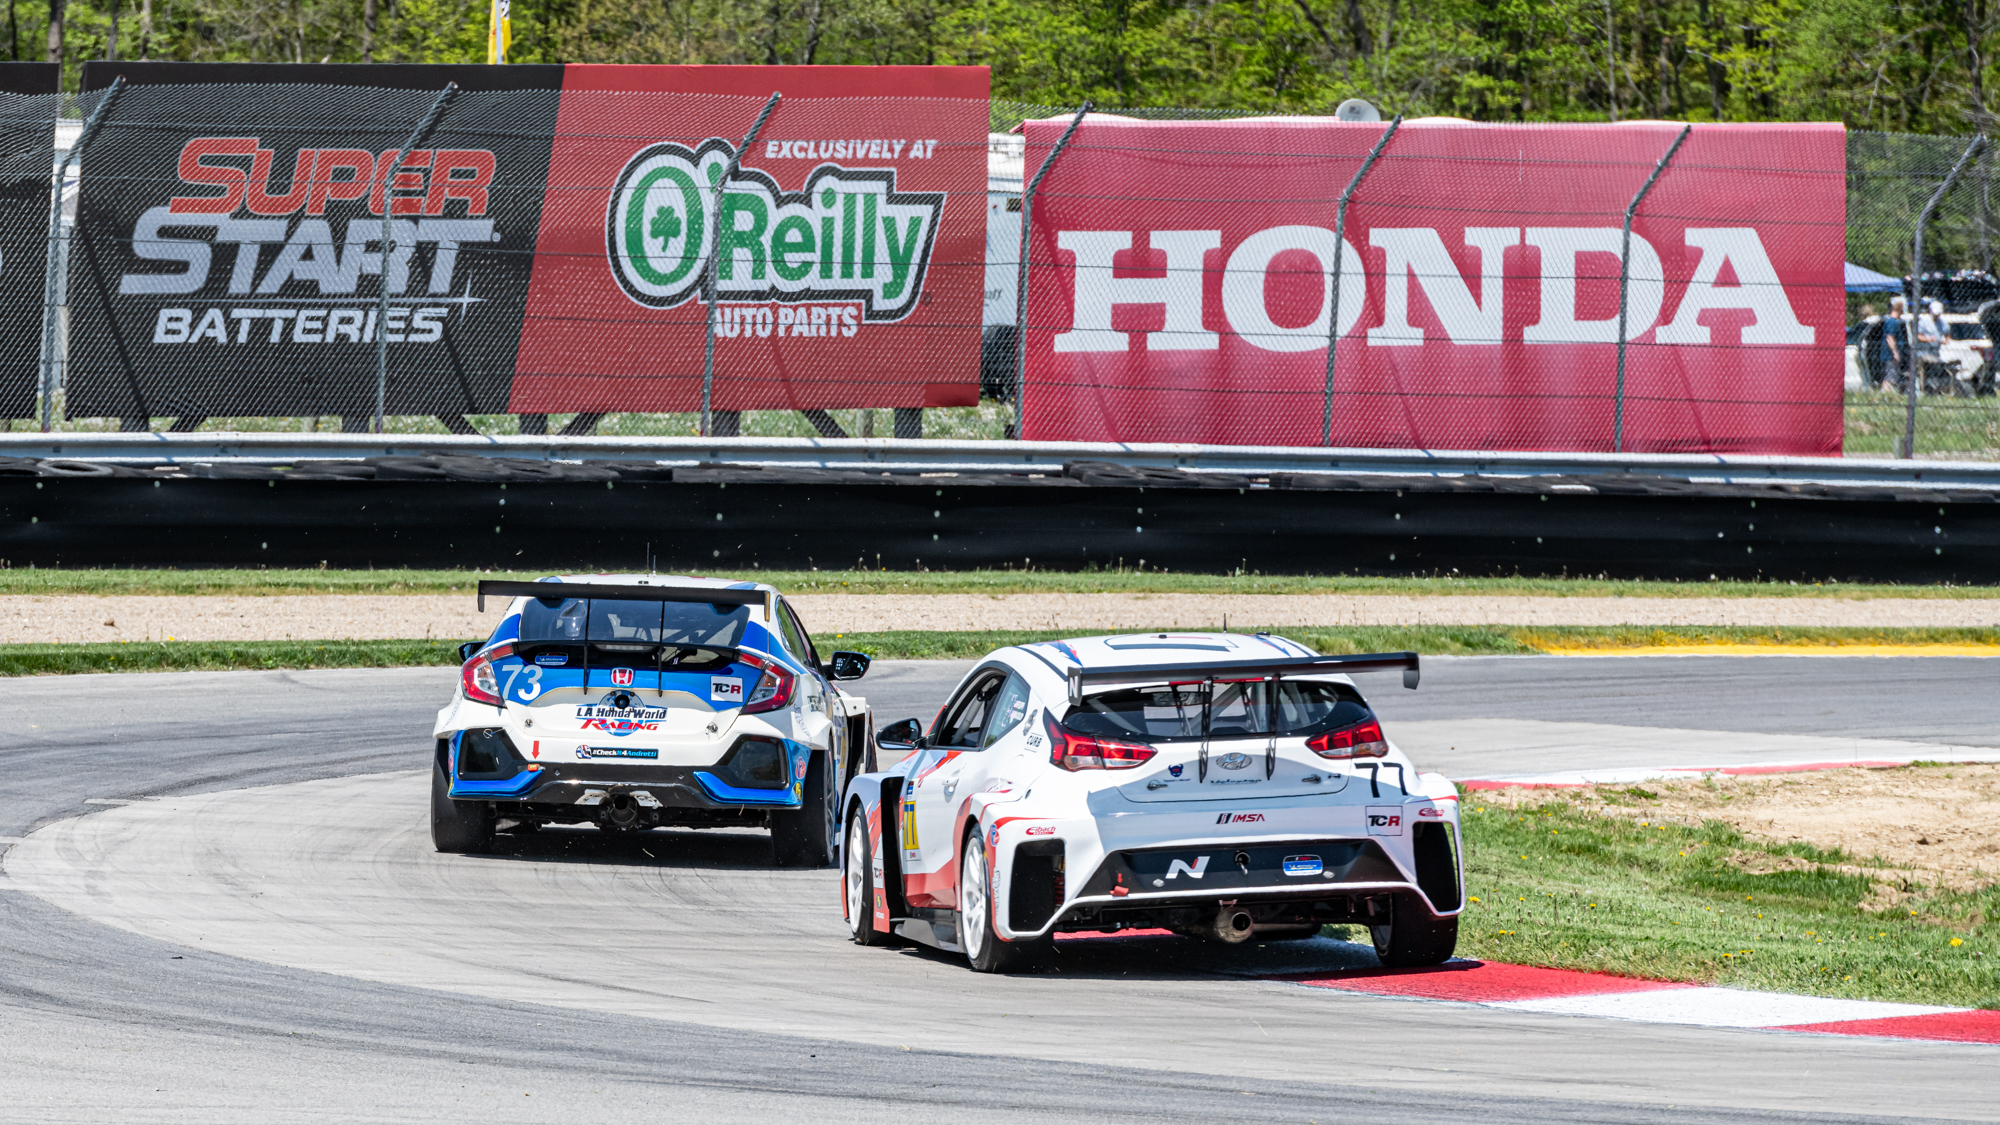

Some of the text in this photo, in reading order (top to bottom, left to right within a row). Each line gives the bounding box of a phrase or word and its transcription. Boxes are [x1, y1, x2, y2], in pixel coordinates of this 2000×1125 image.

[765, 139, 938, 160] EXCLUSIVELY AT
[168, 137, 497, 216] SUPER
[623, 160, 925, 301] O'Reilly
[118, 206, 496, 296] START
[1054, 224, 1816, 353] HONDA
[152, 306, 450, 345] BATTERIES
[713, 306, 859, 339] AUTO PARTS
[501, 664, 543, 701] 73
[712, 682, 742, 695] TCR
[1068, 675, 1080, 699] N
[576, 706, 667, 720] LA Honda World
[580, 718, 660, 731] RACING
[1354, 762, 1408, 798] 77
[1231, 813, 1266, 823] IMSA
[1367, 815, 1401, 827] TCR
[1164, 855, 1211, 880] N
